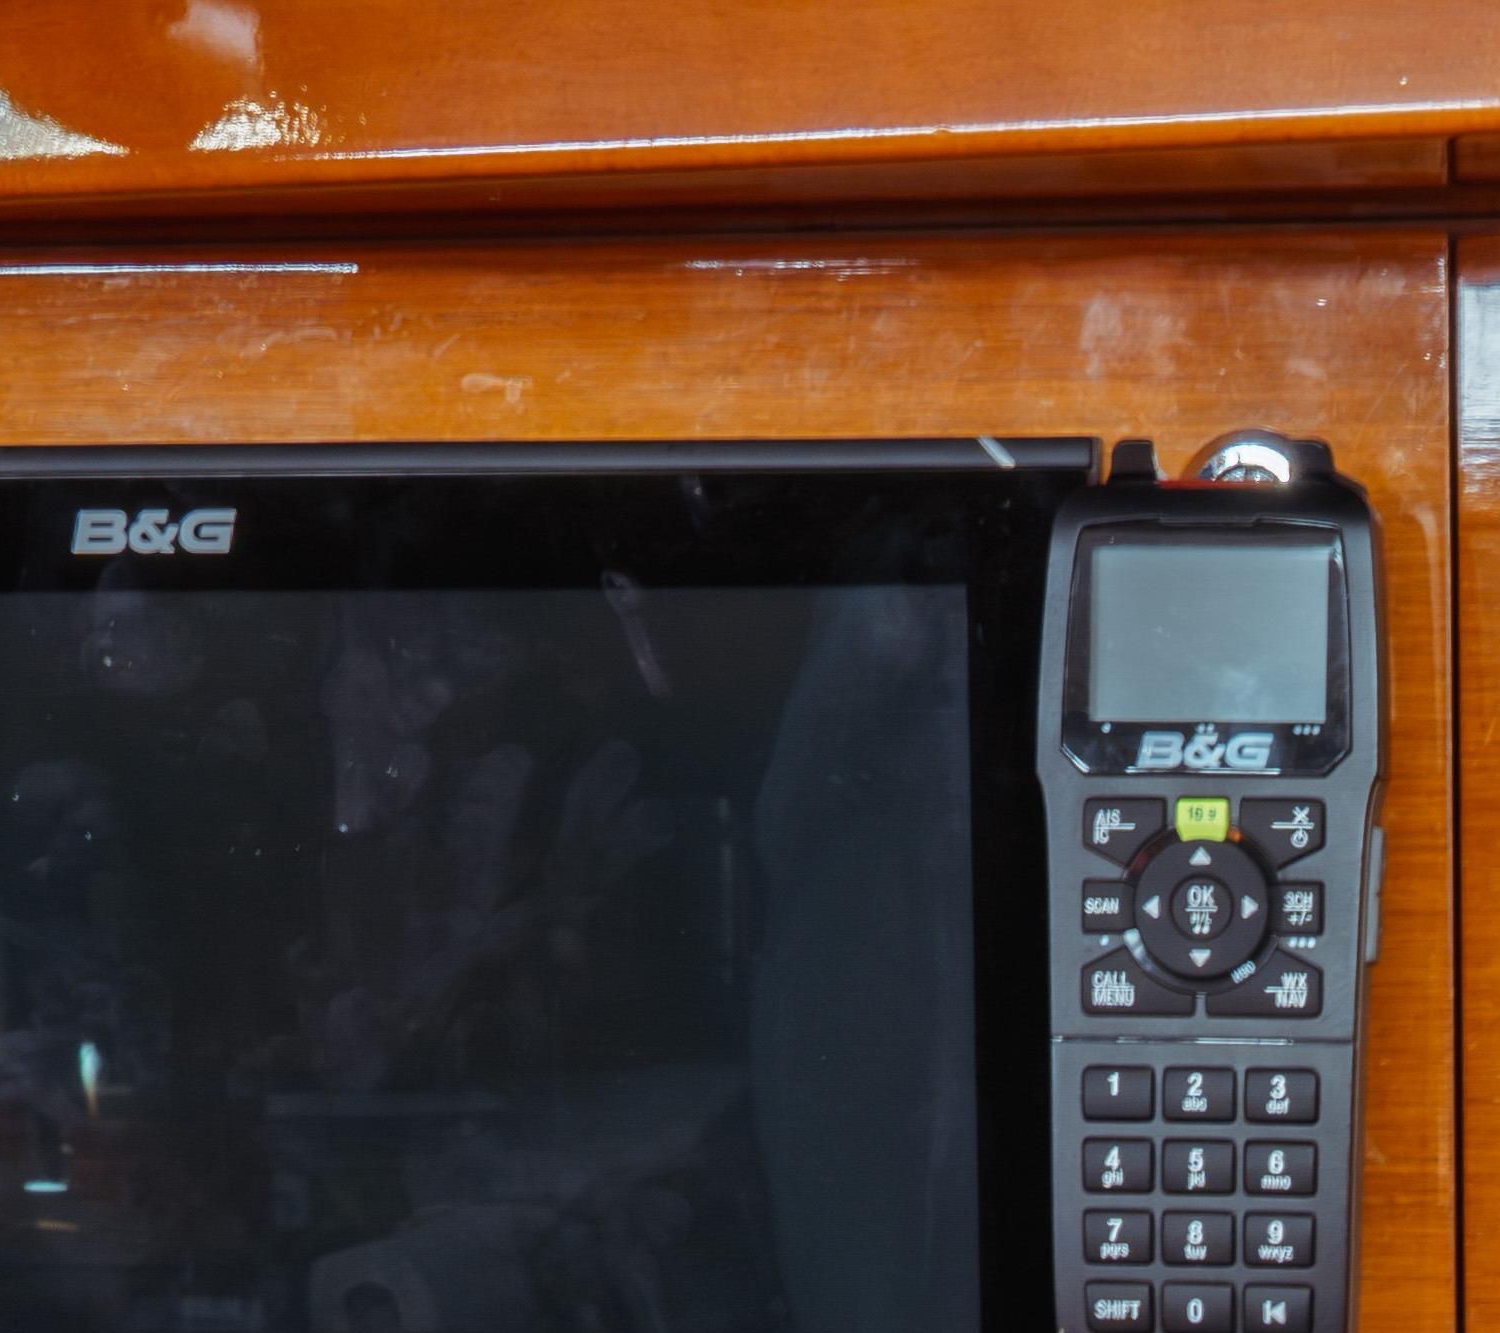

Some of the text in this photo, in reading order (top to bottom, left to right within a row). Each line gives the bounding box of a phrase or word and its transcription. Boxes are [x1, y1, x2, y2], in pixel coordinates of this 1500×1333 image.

[71, 508, 237, 554] B&G
[1135, 730, 1273, 768] B&G
[1084, 898, 1120, 914] SCAN
[1186, 885, 1215, 906] OK
[1092, 970, 1129, 986] CALL
[1092, 988, 1135, 1006] MENU
[1275, 990, 1308, 1008] NAV
[1106, 1072, 1120, 1096] 1
[1187, 1072, 1203, 1097] 2
[1269, 1074, 1287, 1099] 3
[1104, 1146, 1120, 1169] 4
[1188, 1148, 1204, 1172] 5
[1268, 1150, 1284, 1174] 6
[1106, 1218, 1122, 1242] 7
[1187, 1220, 1203, 1244] 8
[1267, 1220, 1284, 1244] 9
[1094, 1299, 1141, 1320] SHIFT
[1186, 1298, 1204, 1323] 0
